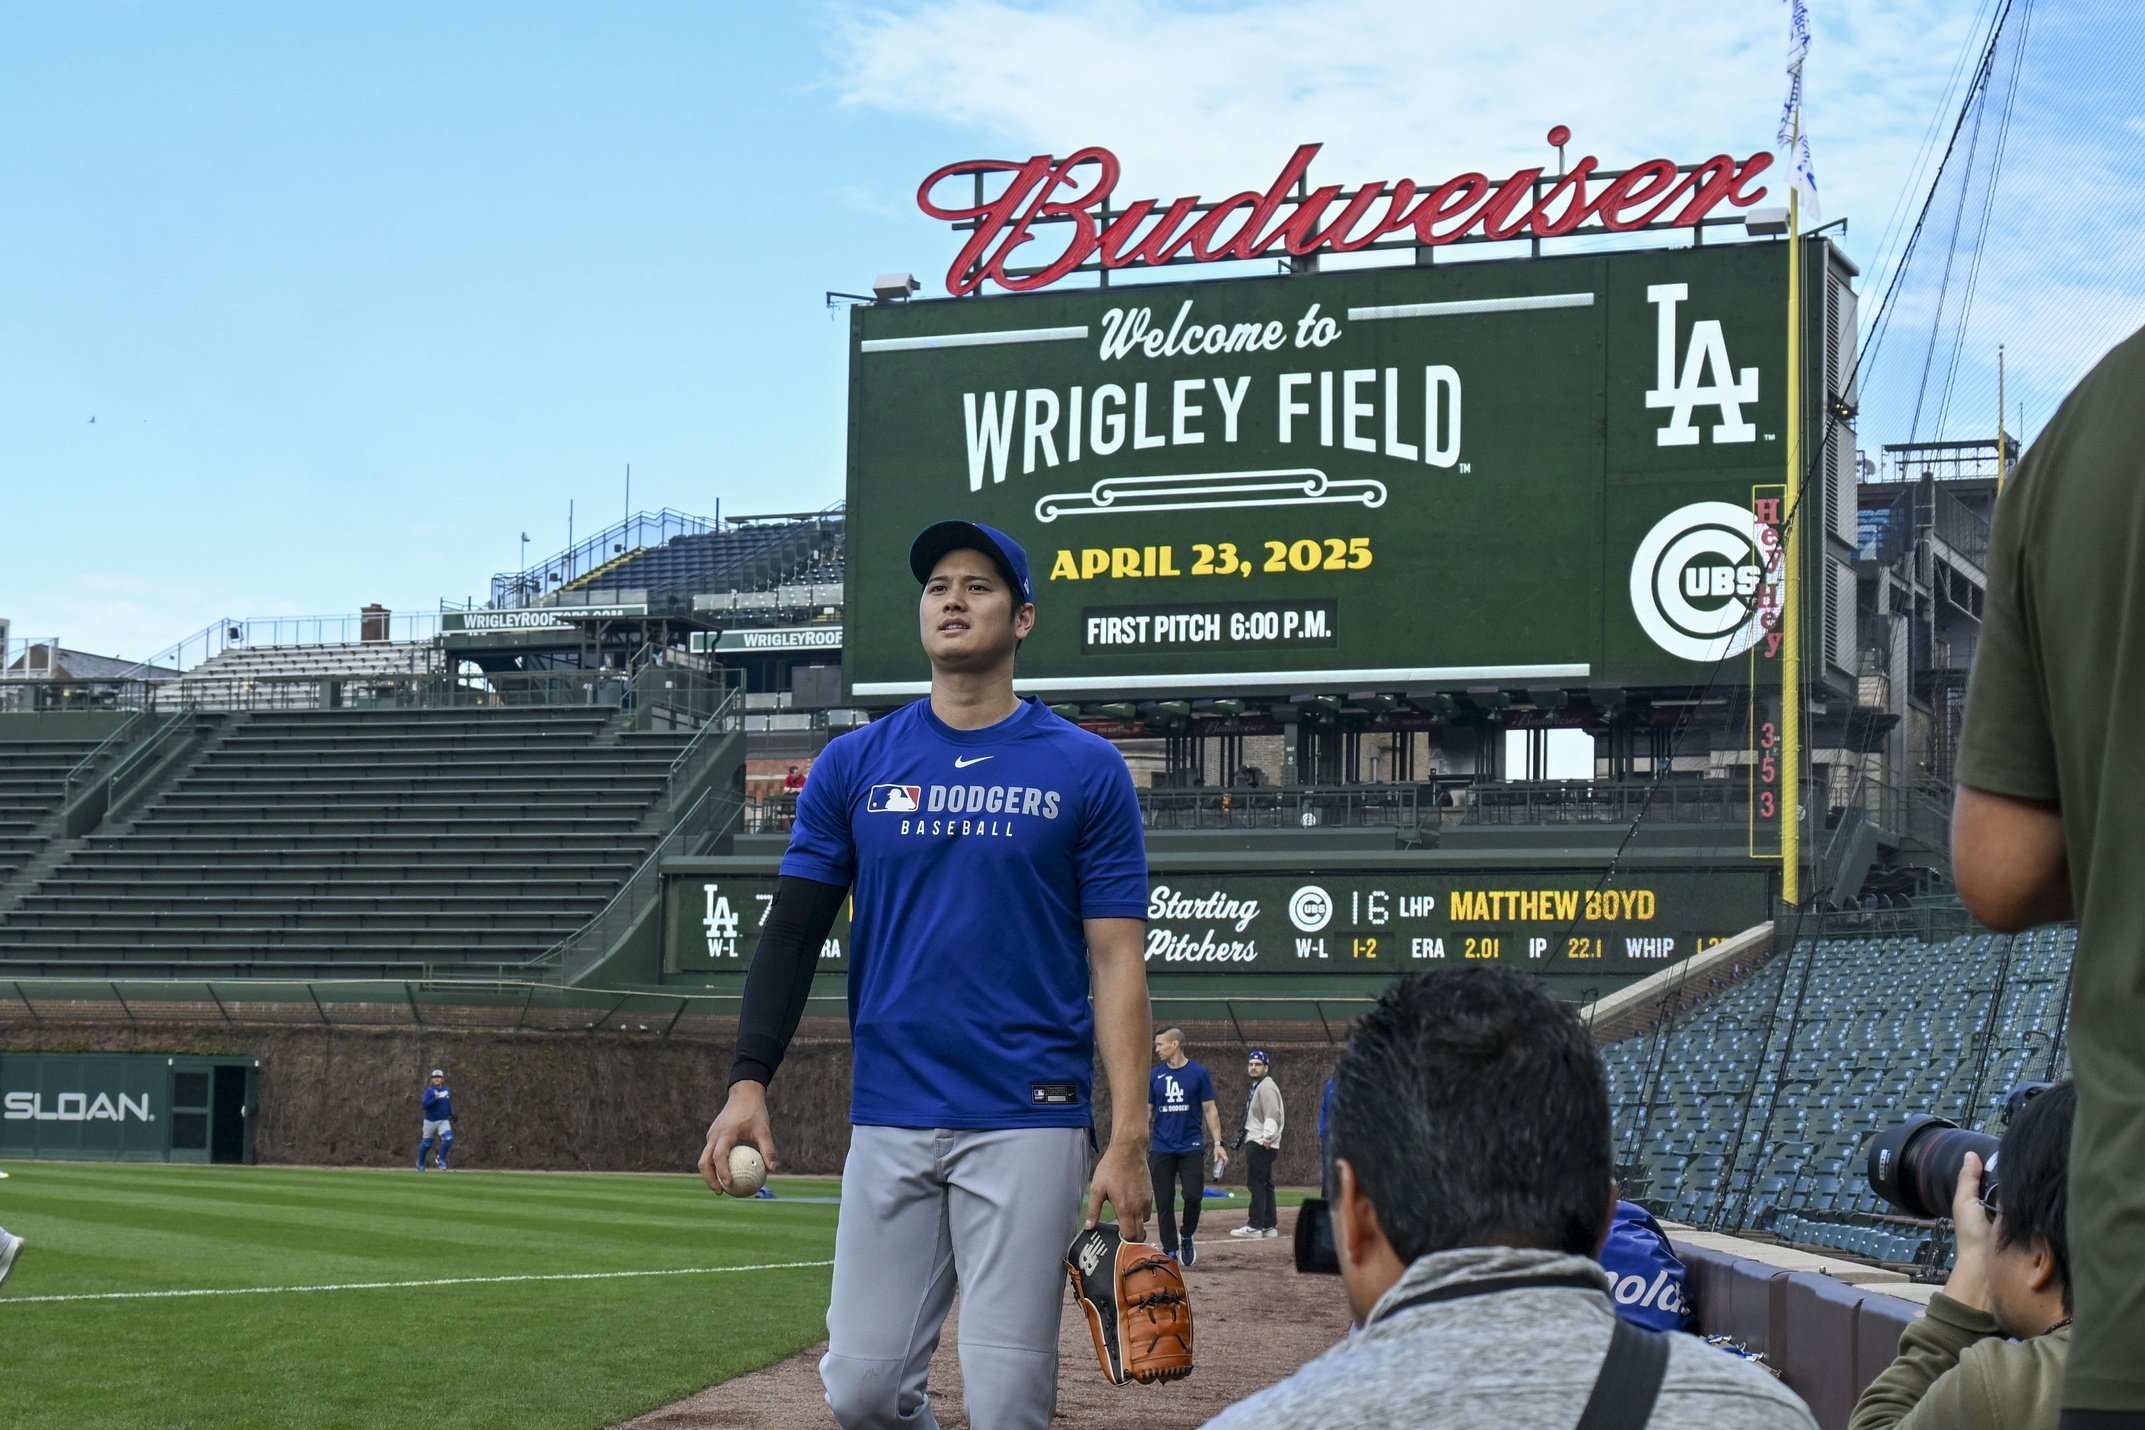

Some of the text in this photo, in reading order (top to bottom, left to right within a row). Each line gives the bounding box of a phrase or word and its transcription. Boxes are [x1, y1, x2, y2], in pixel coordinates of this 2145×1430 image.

[917, 125, 1773, 296] Budweiser
[1099, 299, 1342, 361] Welcome to
[1645, 282, 1759, 447] LA
[963, 376, 1252, 492] WRIGLEY
[1279, 364, 1462, 469] FIELD
[1050, 537, 1373, 581] APRIL 23, 2025
[1087, 610, 1332, 645] FIRST PITCH 6:00 P.M.
[927, 784, 1061, 820] DODGERS
[900, 820, 1013, 837] BASEBALL
[702, 883, 739, 938] LA
[1147, 885, 1261, 933] Starting
[1352, 890, 1390, 925] 16
[1399, 896, 1435, 918] LHP
[1450, 890, 1579, 921] MATTHEW
[1585, 889, 1656, 921] BOYD
[707, 938, 739, 958] W-L
[819, 938, 842, 958] RA
[1143, 928, 1259, 962] Pitchers
[1295, 938, 1329, 959] W-L
[1353, 938, 1377, 958] 1-2
[1411, 937, 1446, 959] ERA
[1465, 938, 1499, 958] 2.01
[1529, 937, 1548, 959] IP
[1568, 937, 1602, 959] 22.1
[1626, 937, 1675, 959] WHIP
[1165, 1076, 1184, 1103] LA
